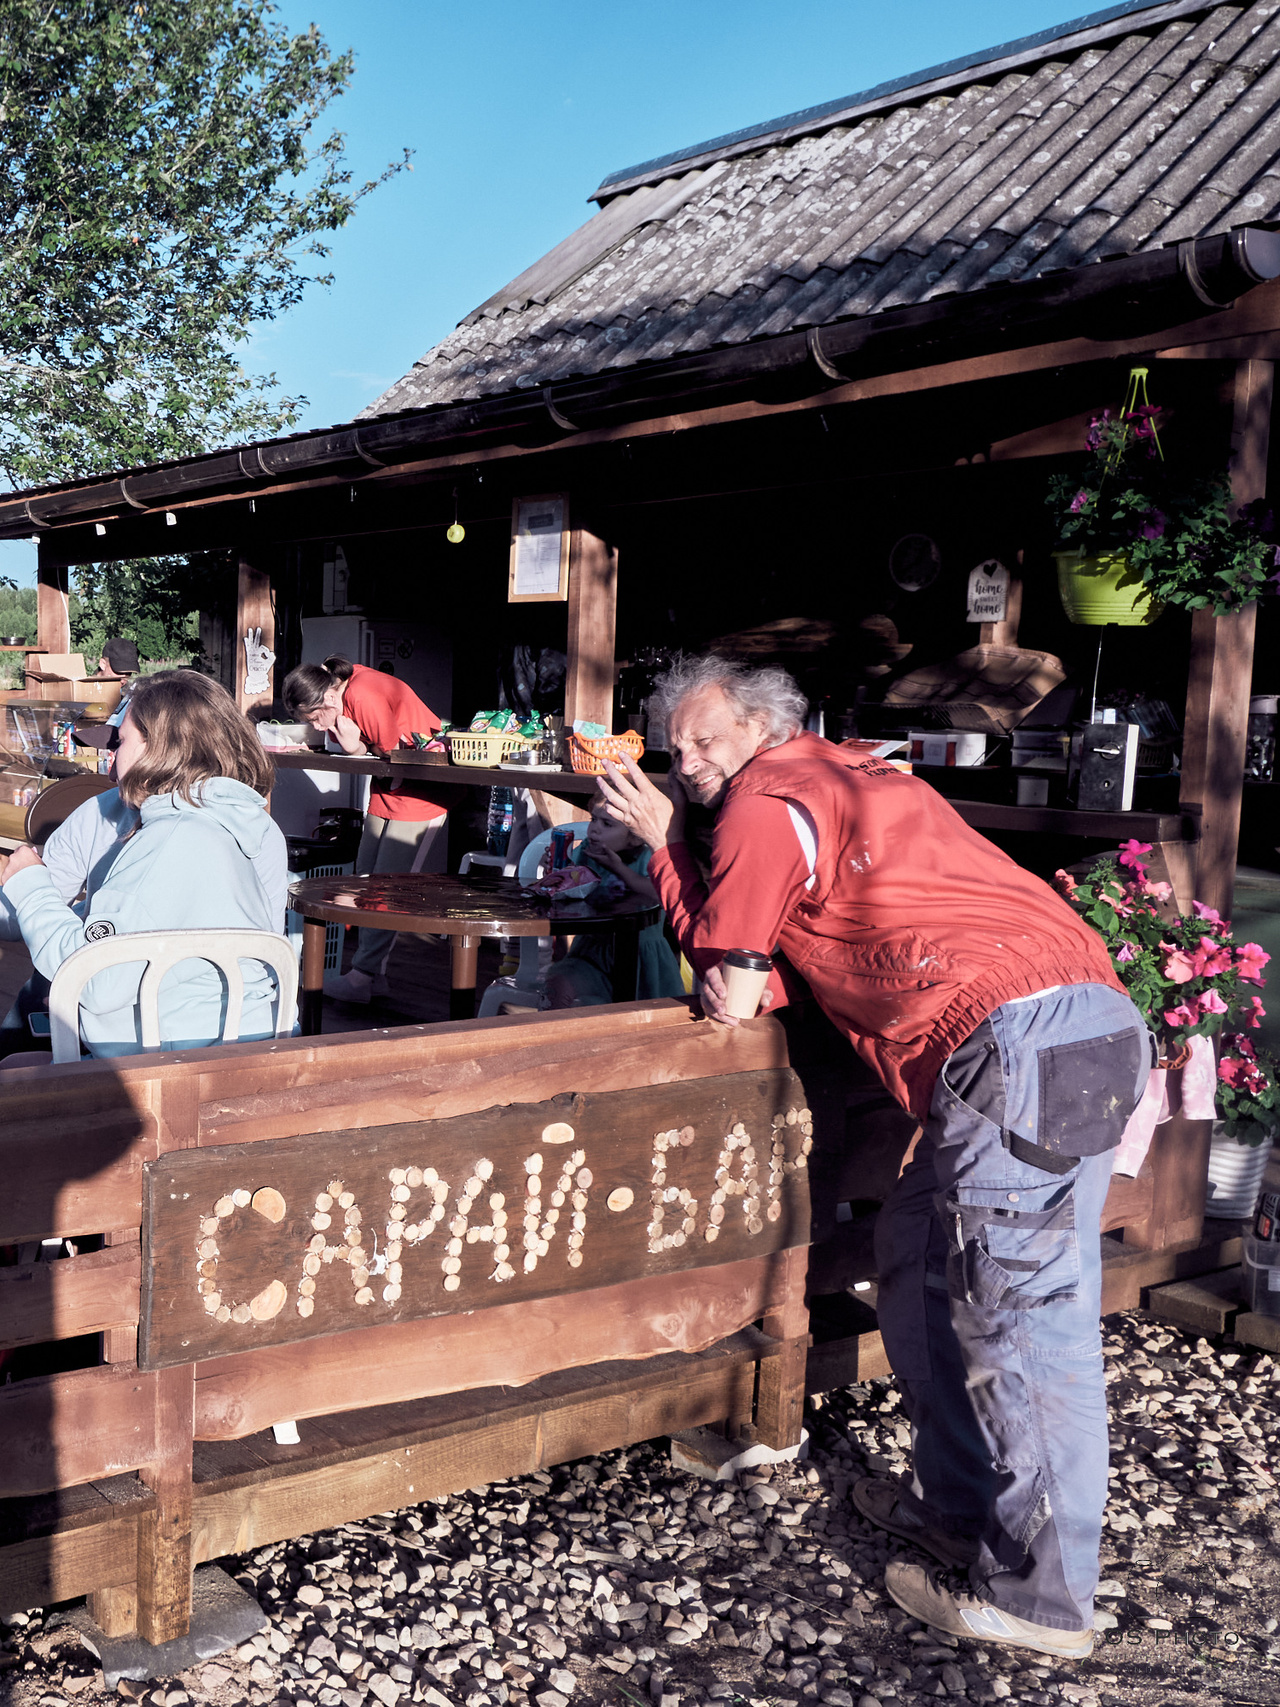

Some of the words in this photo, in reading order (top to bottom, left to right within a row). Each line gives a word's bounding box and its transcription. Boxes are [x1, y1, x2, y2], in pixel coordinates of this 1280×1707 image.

[975, 579, 1004, 595] home
[973, 599, 1002, 615] home
[195, 1121, 595, 1324] САРАЙ
[647, 1107, 814, 1254] БАР
